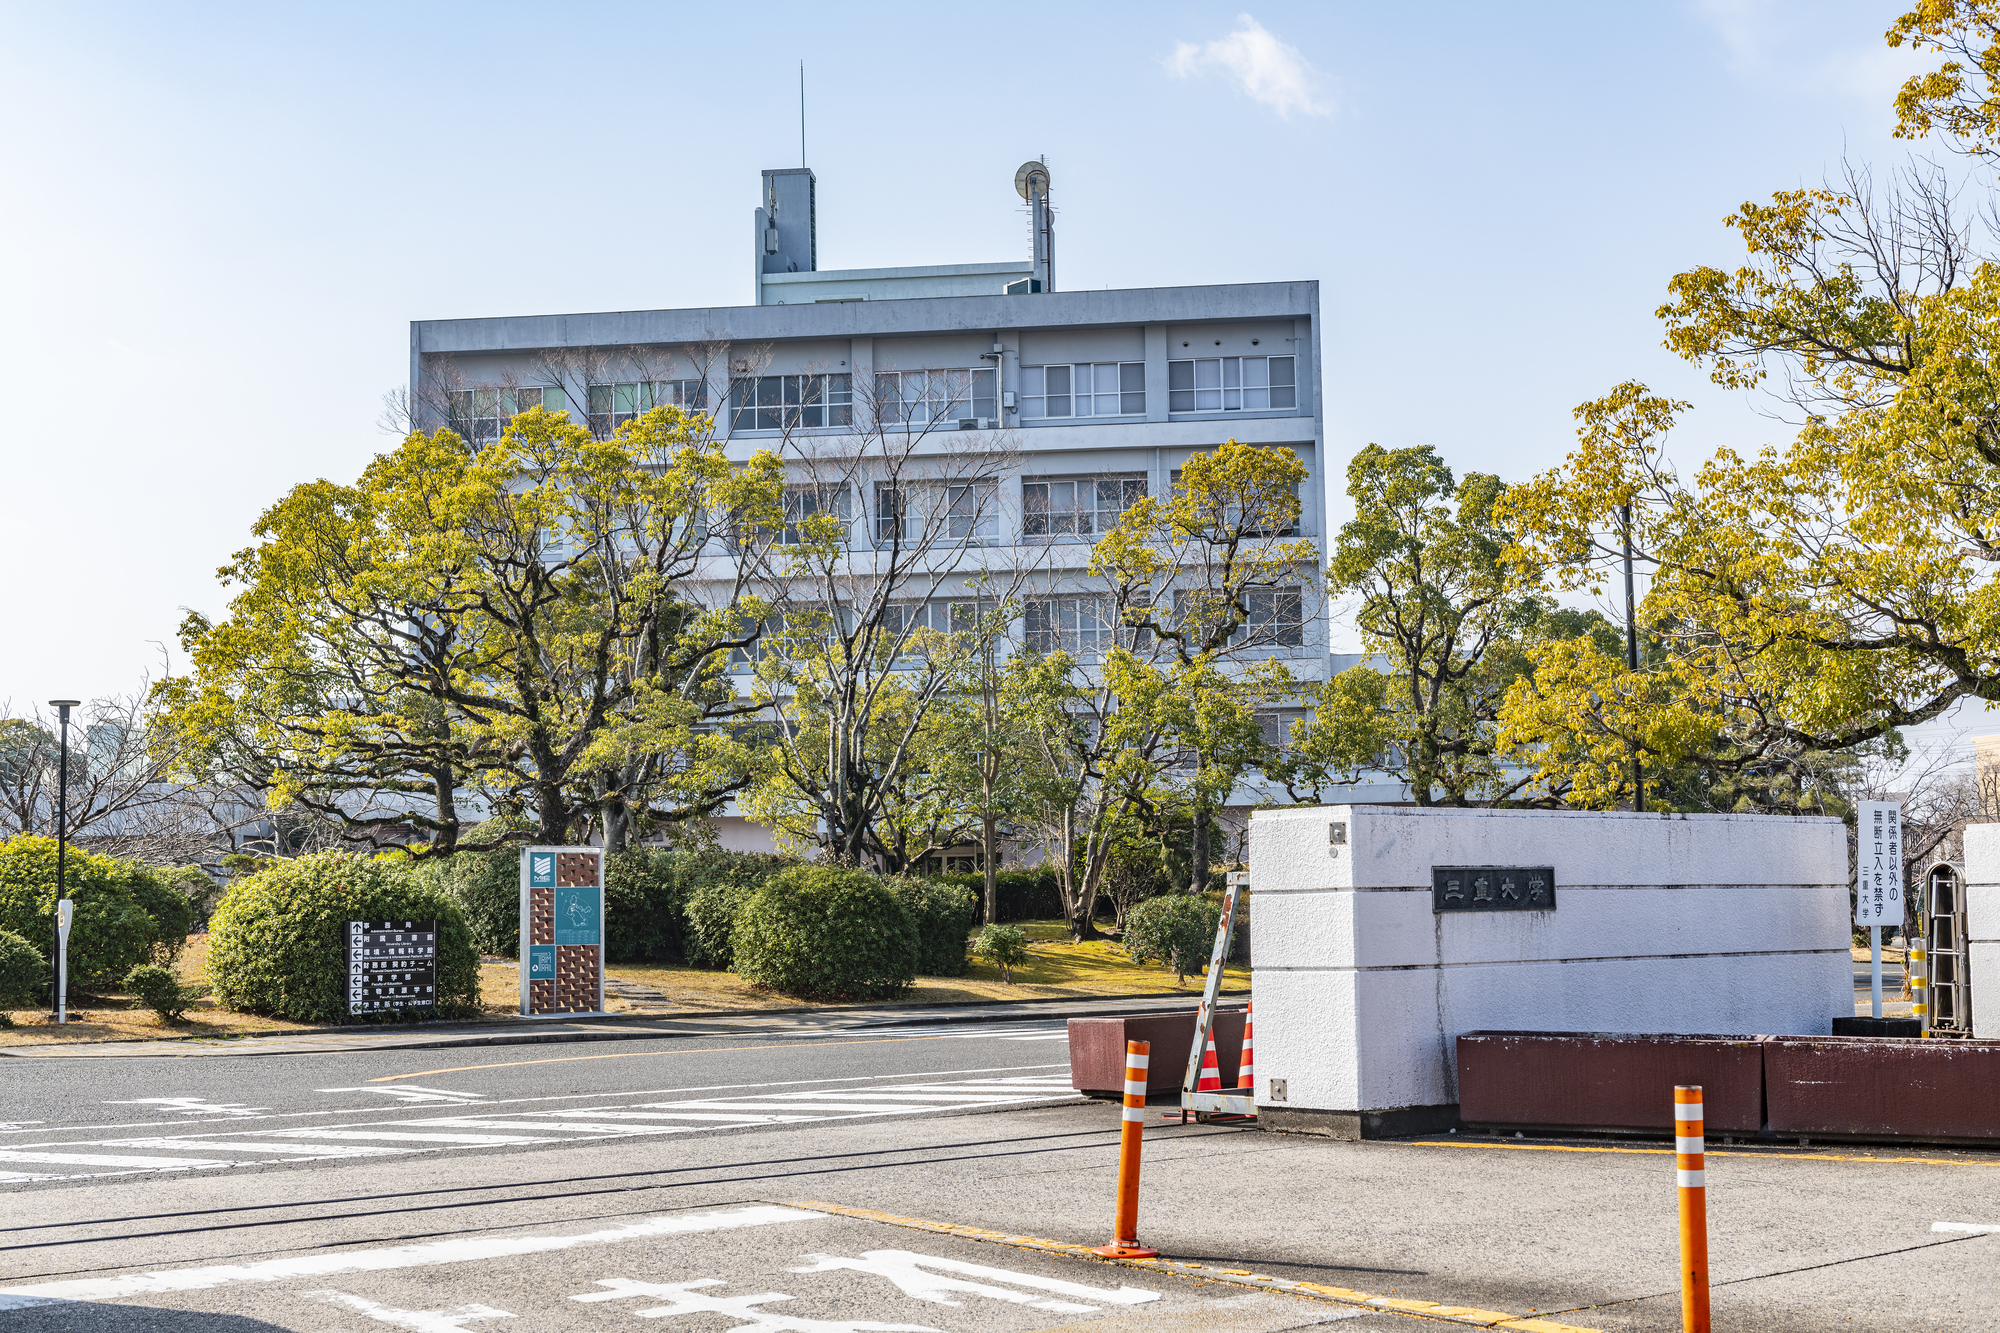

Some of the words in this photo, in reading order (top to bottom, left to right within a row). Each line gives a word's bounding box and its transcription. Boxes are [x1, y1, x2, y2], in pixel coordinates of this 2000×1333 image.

[1873, 809, 1884, 917] 無断立入を禁ず
[1888, 809, 1898, 901] 関係者以外の
[1445, 877, 1545, 901] 三重大学
[363, 974, 411, 982] 教育学部
